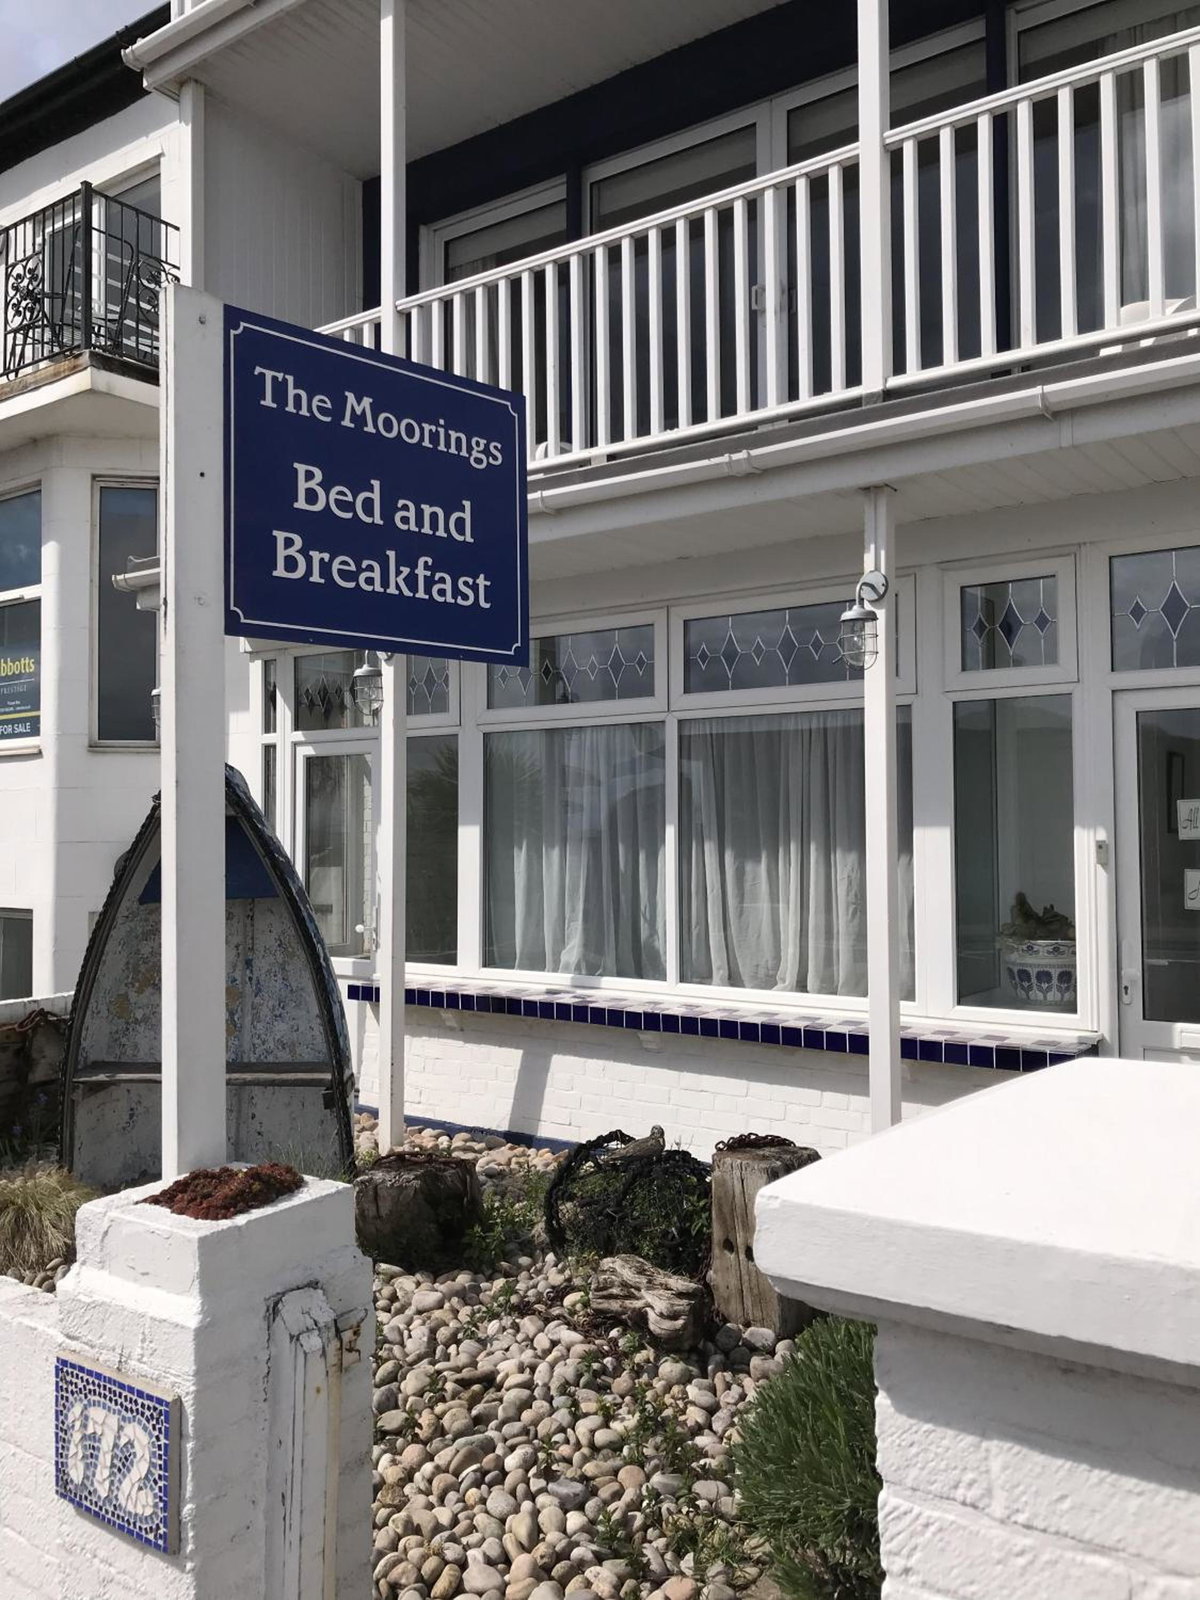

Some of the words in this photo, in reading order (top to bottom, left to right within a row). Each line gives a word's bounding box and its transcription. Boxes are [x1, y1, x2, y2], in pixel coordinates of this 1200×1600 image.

[253, 366, 332, 422] The
[341, 391, 503, 469] Moorings
[293, 462, 384, 525] Bed
[394, 500, 474, 543] and
[272, 530, 491, 608] Breakfast
[0, 725, 13, 735] FOR
[14, 722, 31, 733] SALE
[68, 1402, 154, 1516] 172
